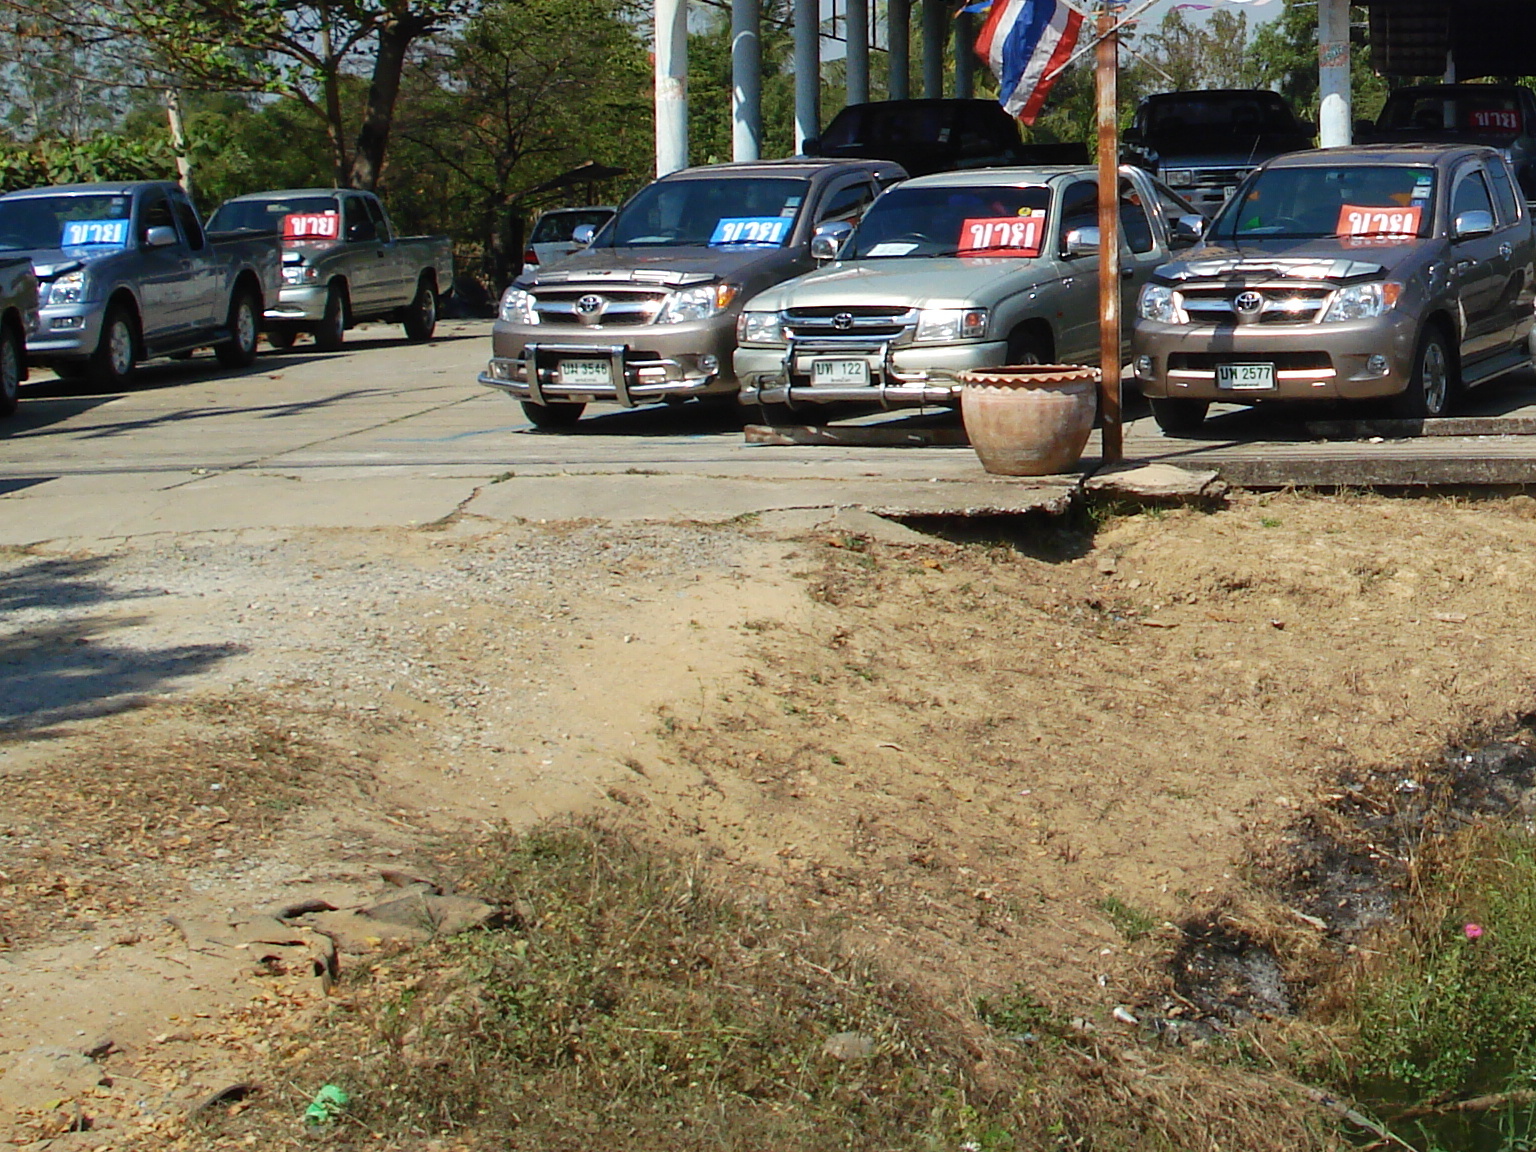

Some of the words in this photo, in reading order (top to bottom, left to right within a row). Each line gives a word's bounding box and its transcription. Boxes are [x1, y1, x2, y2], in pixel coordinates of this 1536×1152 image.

[70, 222, 123, 245] ขาย
[290, 215, 334, 239] ขาย
[722, 222, 784, 243] ขาย
[970, 222, 1035, 249] ขาย
[1349, 212, 1413, 239] ขาย
[581, 362, 608, 375] 3546
[842, 362, 861, 375] 122
[1242, 367, 1271, 380] 2577
